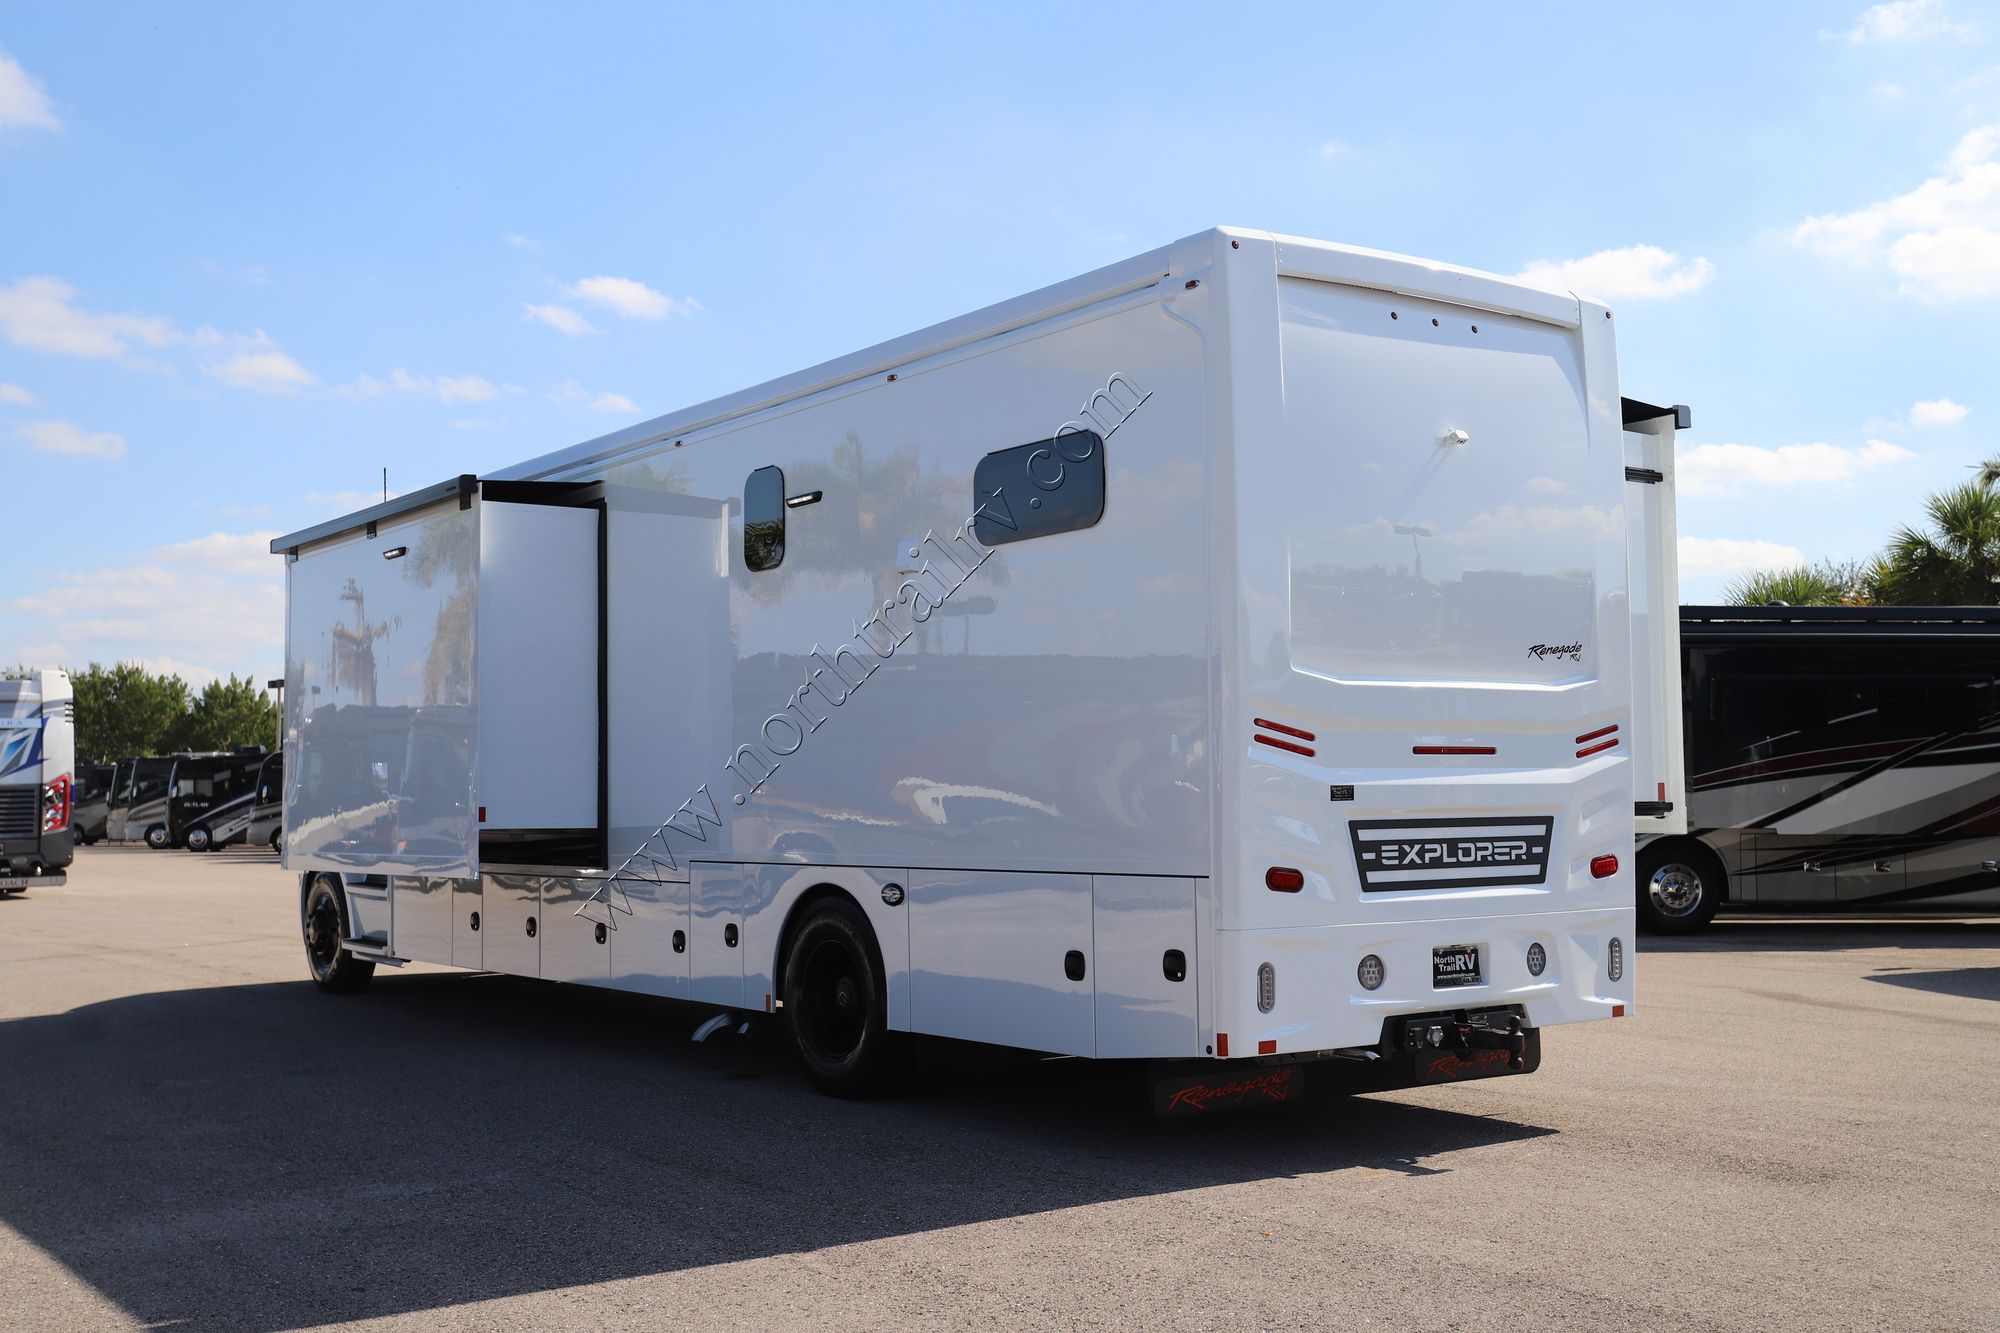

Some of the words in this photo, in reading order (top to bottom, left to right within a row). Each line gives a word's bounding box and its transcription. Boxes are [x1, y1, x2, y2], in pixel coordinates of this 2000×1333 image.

[1528, 641, 1582, 661] Renegade
[1570, 653, 1581, 662] RV
[1381, 840, 1527, 865] EXPLORER
[1434, 955, 1455, 964] North
[1455, 953, 1475, 970] RV
[1168, 1069, 1291, 1110] Renegade
